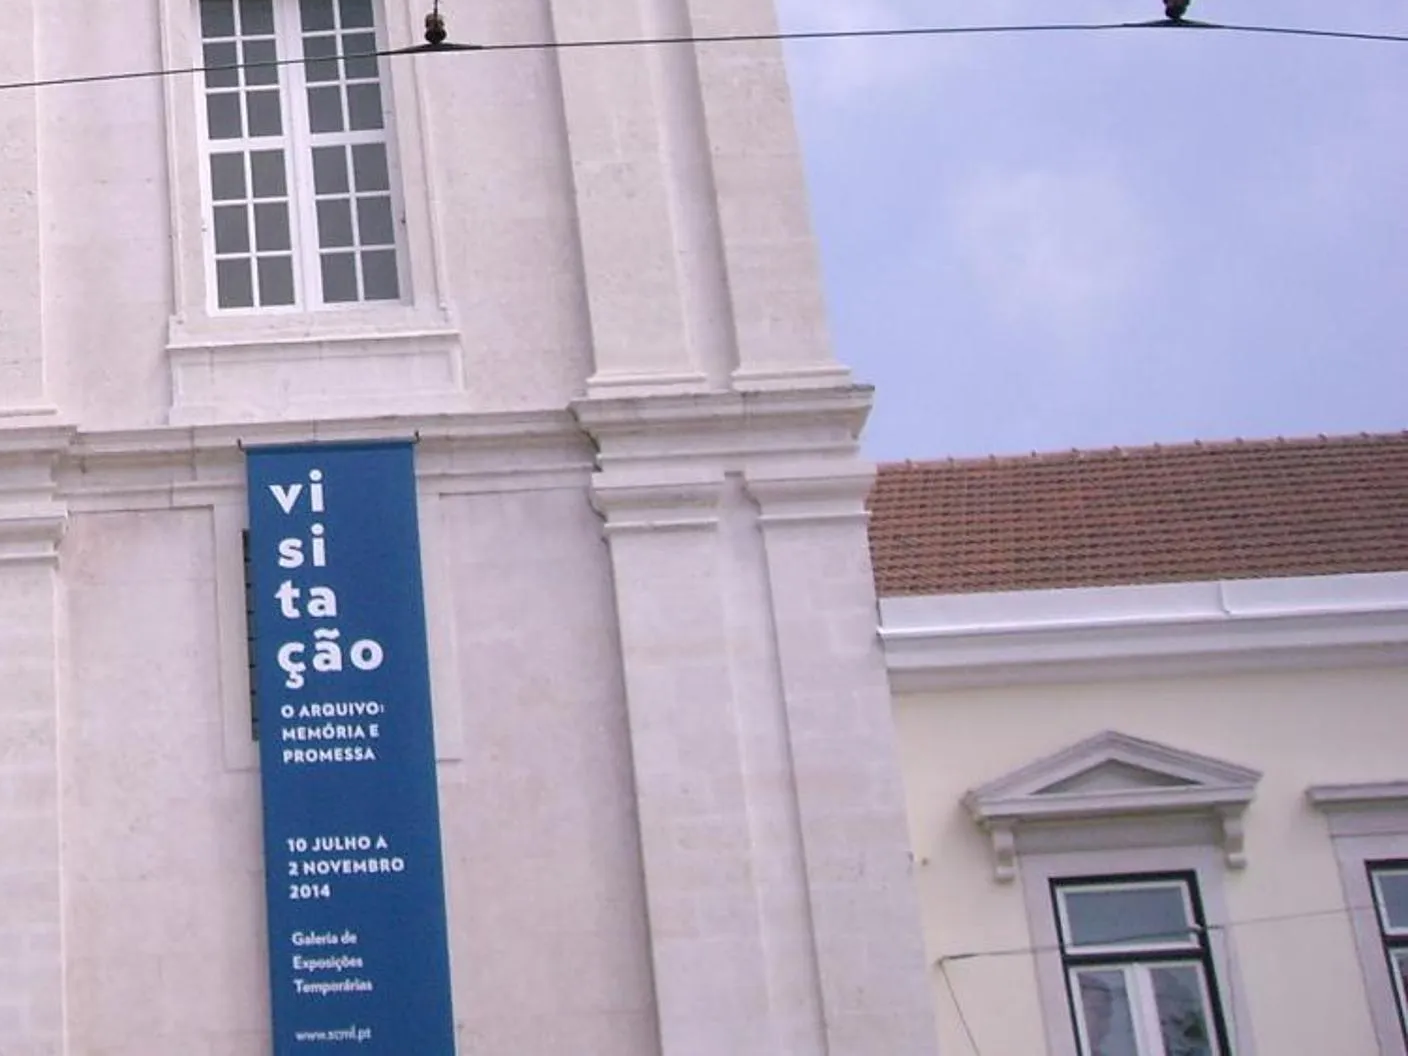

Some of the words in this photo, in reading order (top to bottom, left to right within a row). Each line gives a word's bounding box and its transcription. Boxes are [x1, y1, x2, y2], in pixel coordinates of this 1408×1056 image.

[277, 628, 385, 690] ção
[280, 705, 294, 718] O
[282, 723, 366, 741] MEMÓRIA
[369, 725, 380, 738] E
[282, 748, 376, 764] PROMESSA
[286, 838, 308, 853] 10
[311, 836, 372, 852] JULHO
[375, 835, 388, 849] A
[288, 861, 299, 876] 2
[303, 857, 405, 875] NOVEMBRO
[289, 884, 331, 899] 2014
[291, 931, 339, 947] Galeria
[340, 930, 358, 945] de
